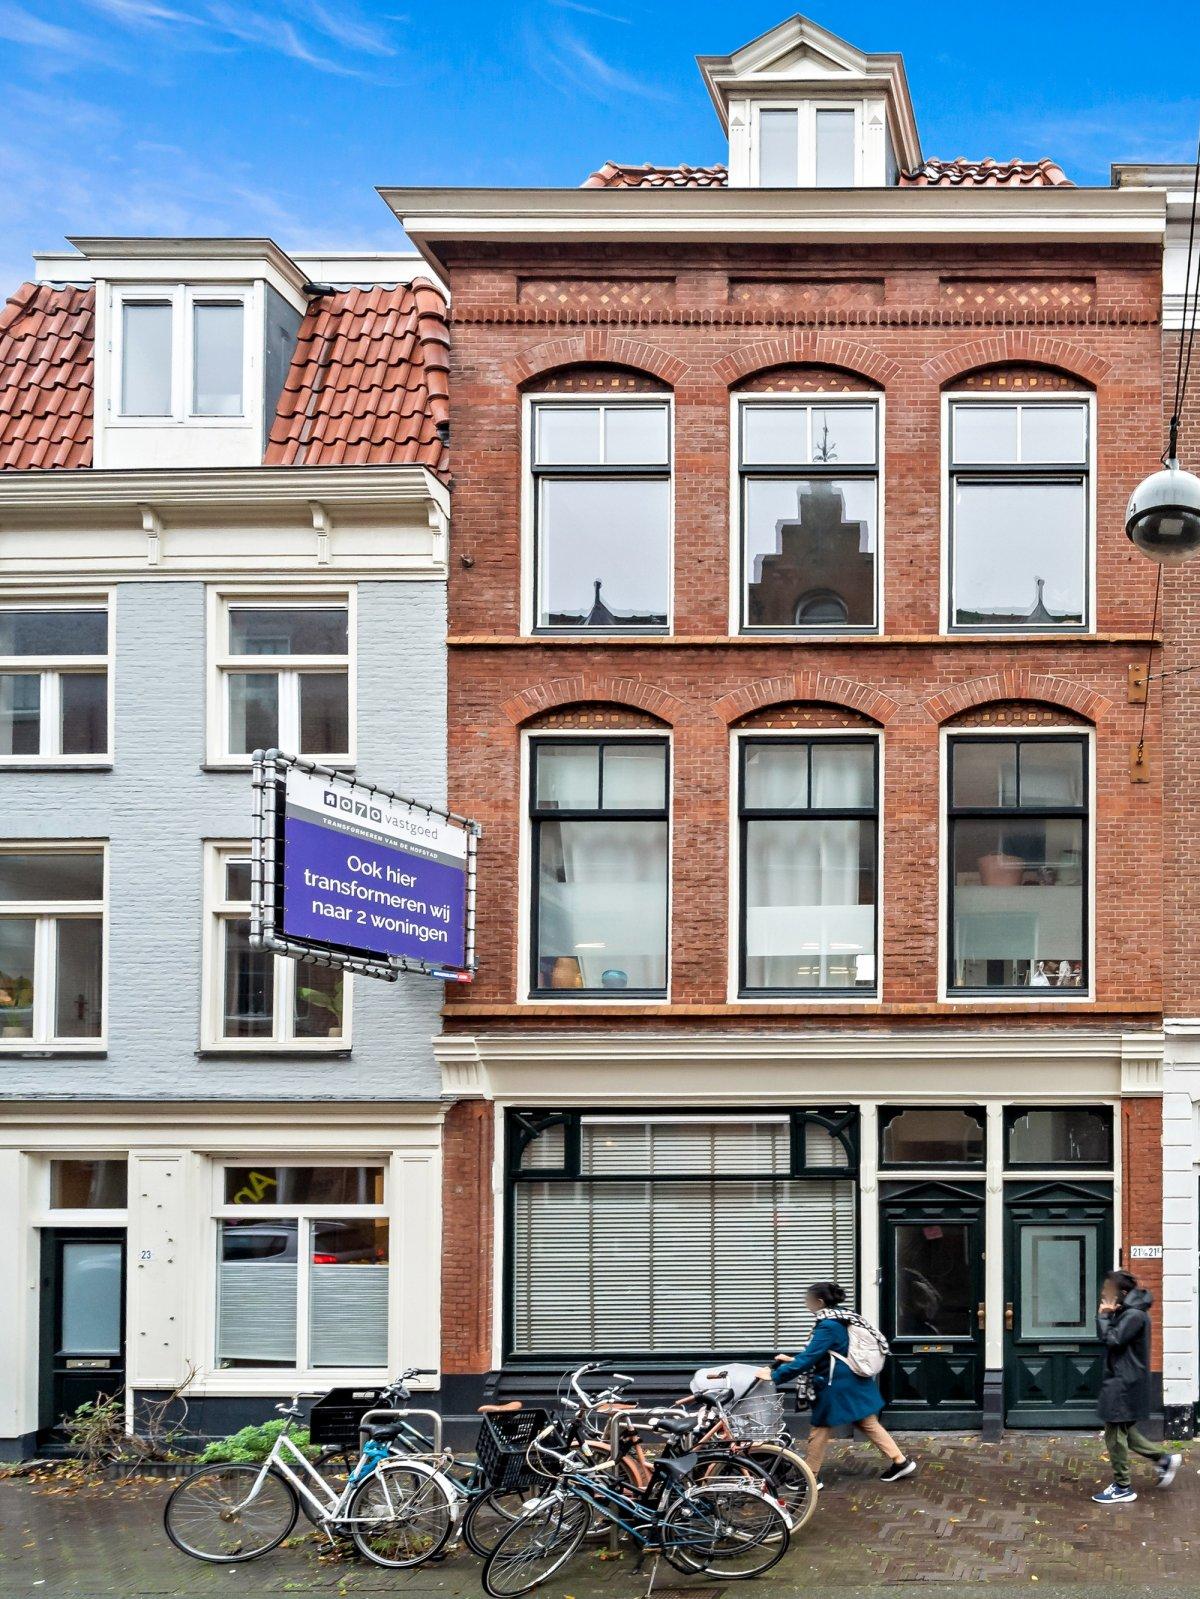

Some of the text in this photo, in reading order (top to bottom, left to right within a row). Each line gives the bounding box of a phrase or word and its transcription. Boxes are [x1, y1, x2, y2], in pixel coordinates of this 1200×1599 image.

[322, 817, 438, 859] TRANSFORMEREN VAN DE HOFSTAD
[385, 813, 438, 839] vastgoed
[347, 855, 417, 888] Ook hier
[304, 868, 450, 923] transformeren wij
[312, 900, 447, 942] naar 2 woningen
[141, 1250, 151, 1260] 23
